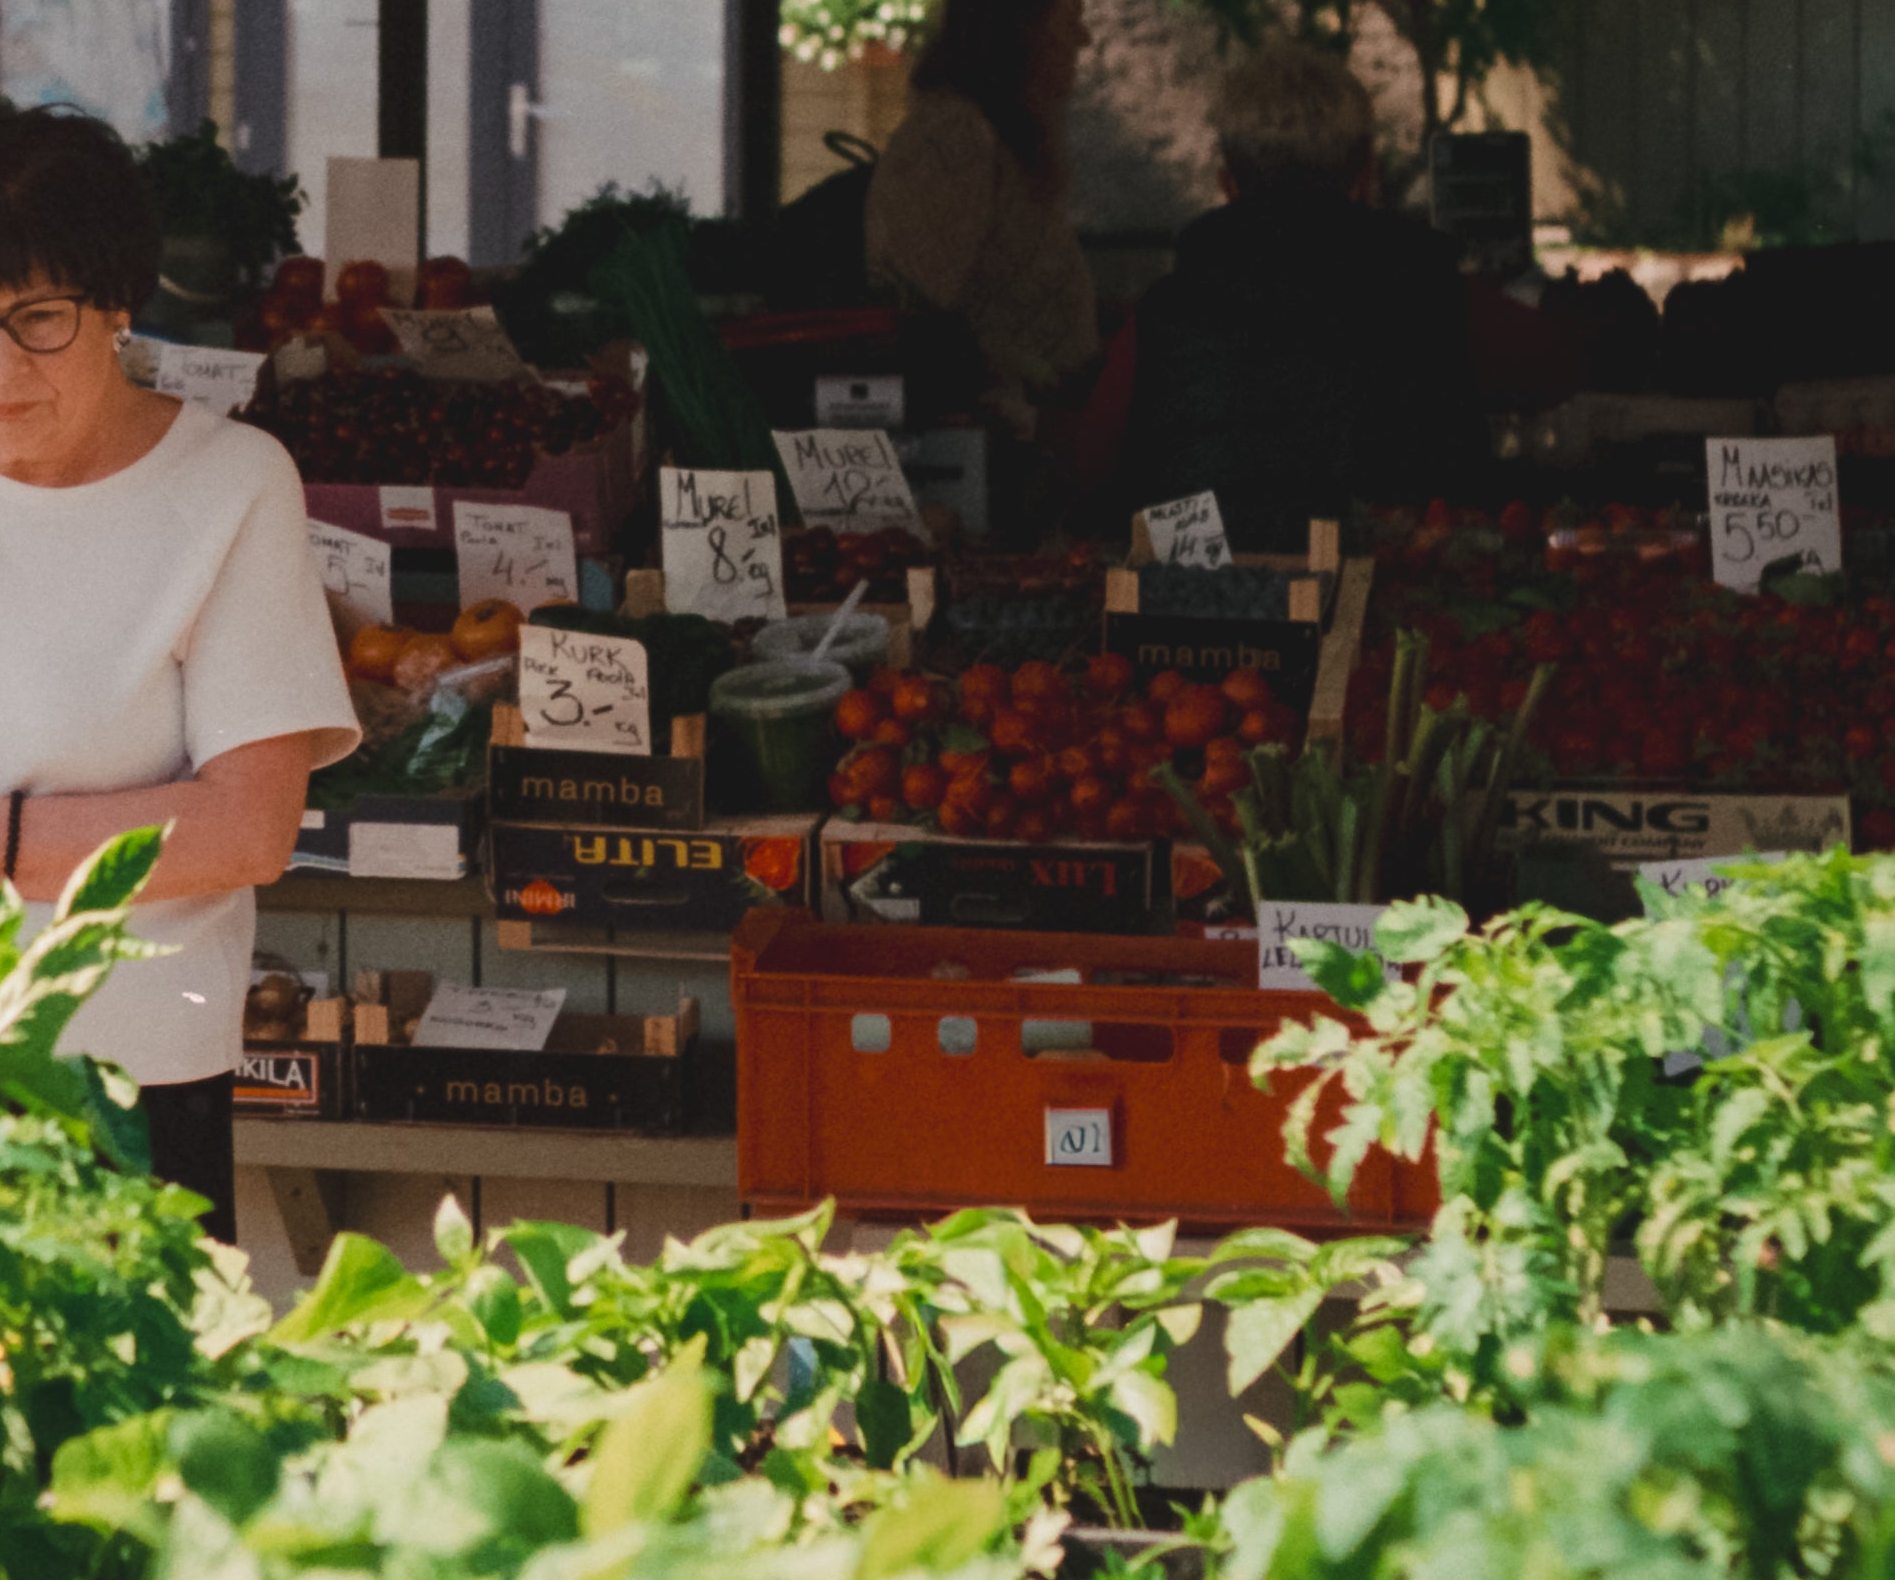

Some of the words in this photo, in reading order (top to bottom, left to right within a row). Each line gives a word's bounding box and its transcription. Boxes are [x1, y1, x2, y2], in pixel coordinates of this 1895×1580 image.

[1137, 640, 1282, 671] mamba
[521, 776, 665, 806] mamba
[1499, 798, 1710, 833] KING
[573, 835, 723, 869] ELITA
[235, 1058, 306, 1092] KILA
[446, 1079, 589, 1109] mamba
